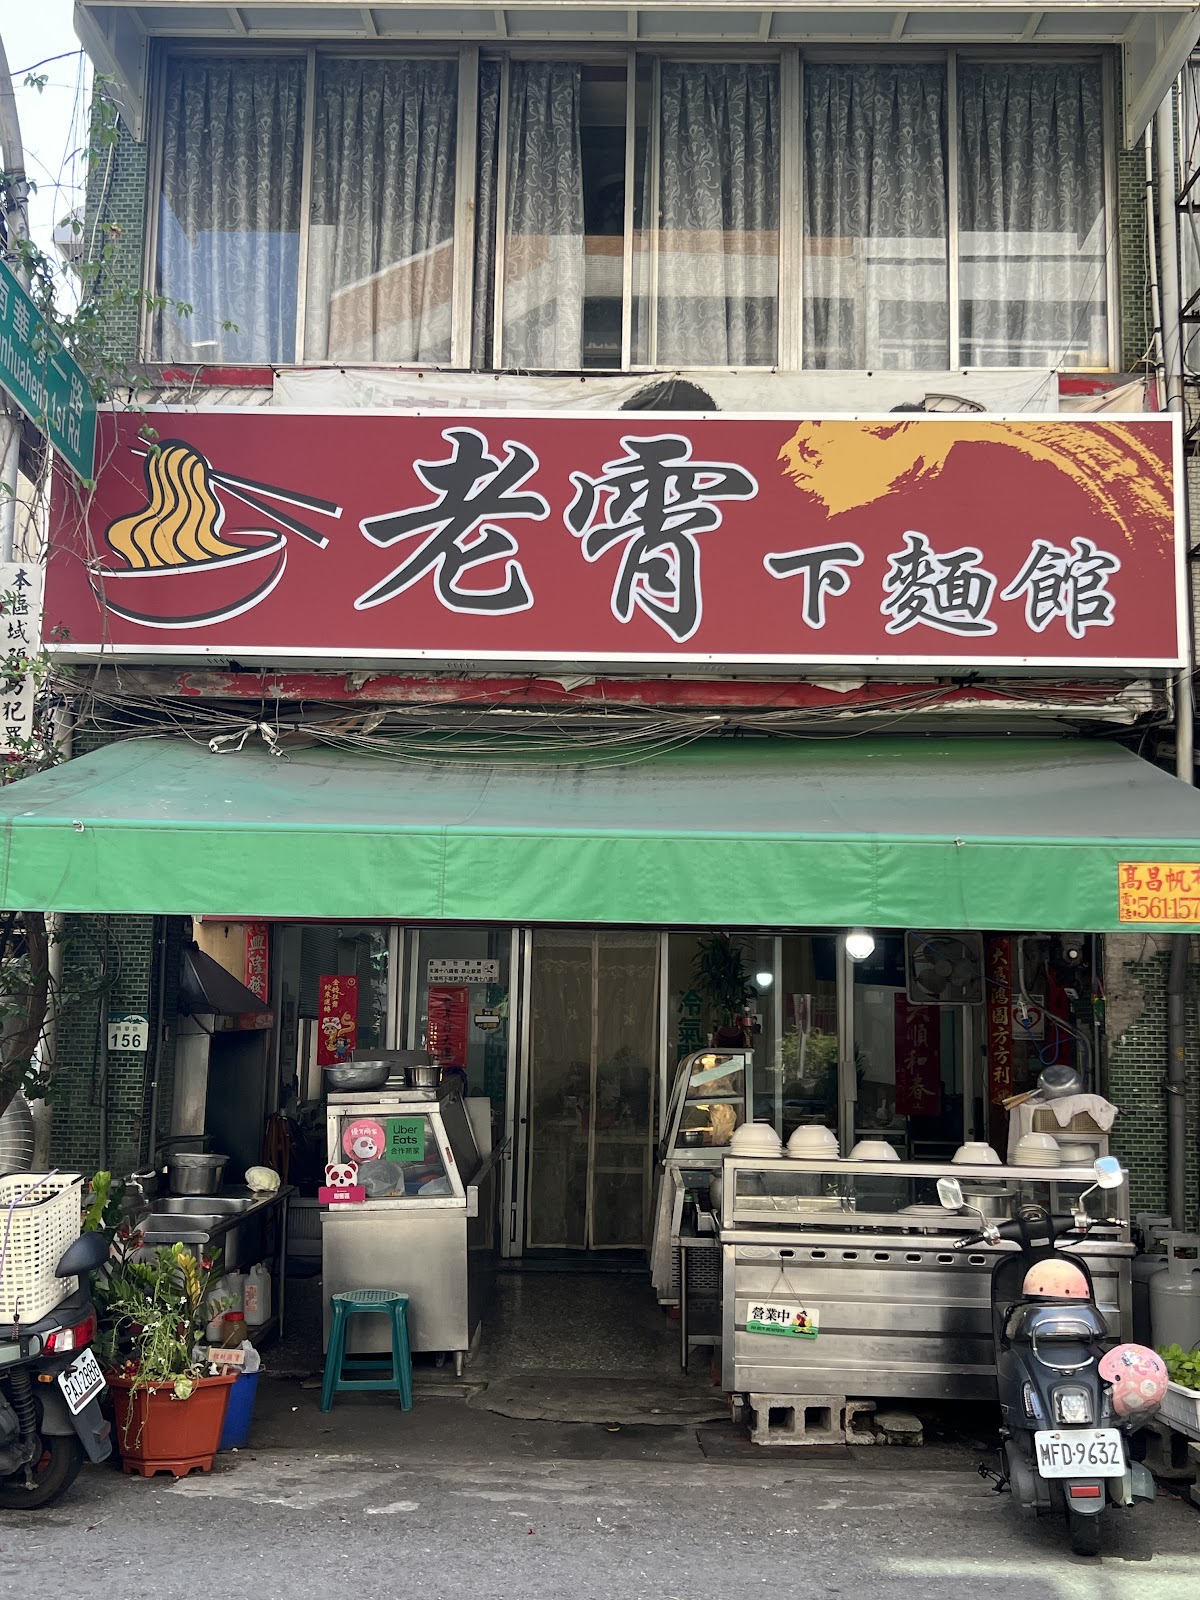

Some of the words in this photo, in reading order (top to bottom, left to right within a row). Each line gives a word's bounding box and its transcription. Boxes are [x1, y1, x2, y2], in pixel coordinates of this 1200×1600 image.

[51, 391, 65, 438] 1st
[67, 416, 81, 458] Rd.
[764, 530, 1121, 639] 下麵館
[991, 948, 1010, 1084] 大展鴻圖方方利
[111, 1033, 141, 1048] 156
[393, 1125, 418, 1134] Uber
[392, 1135, 418, 1145] Eats
[752, 1306, 790, 1322] 營業中
